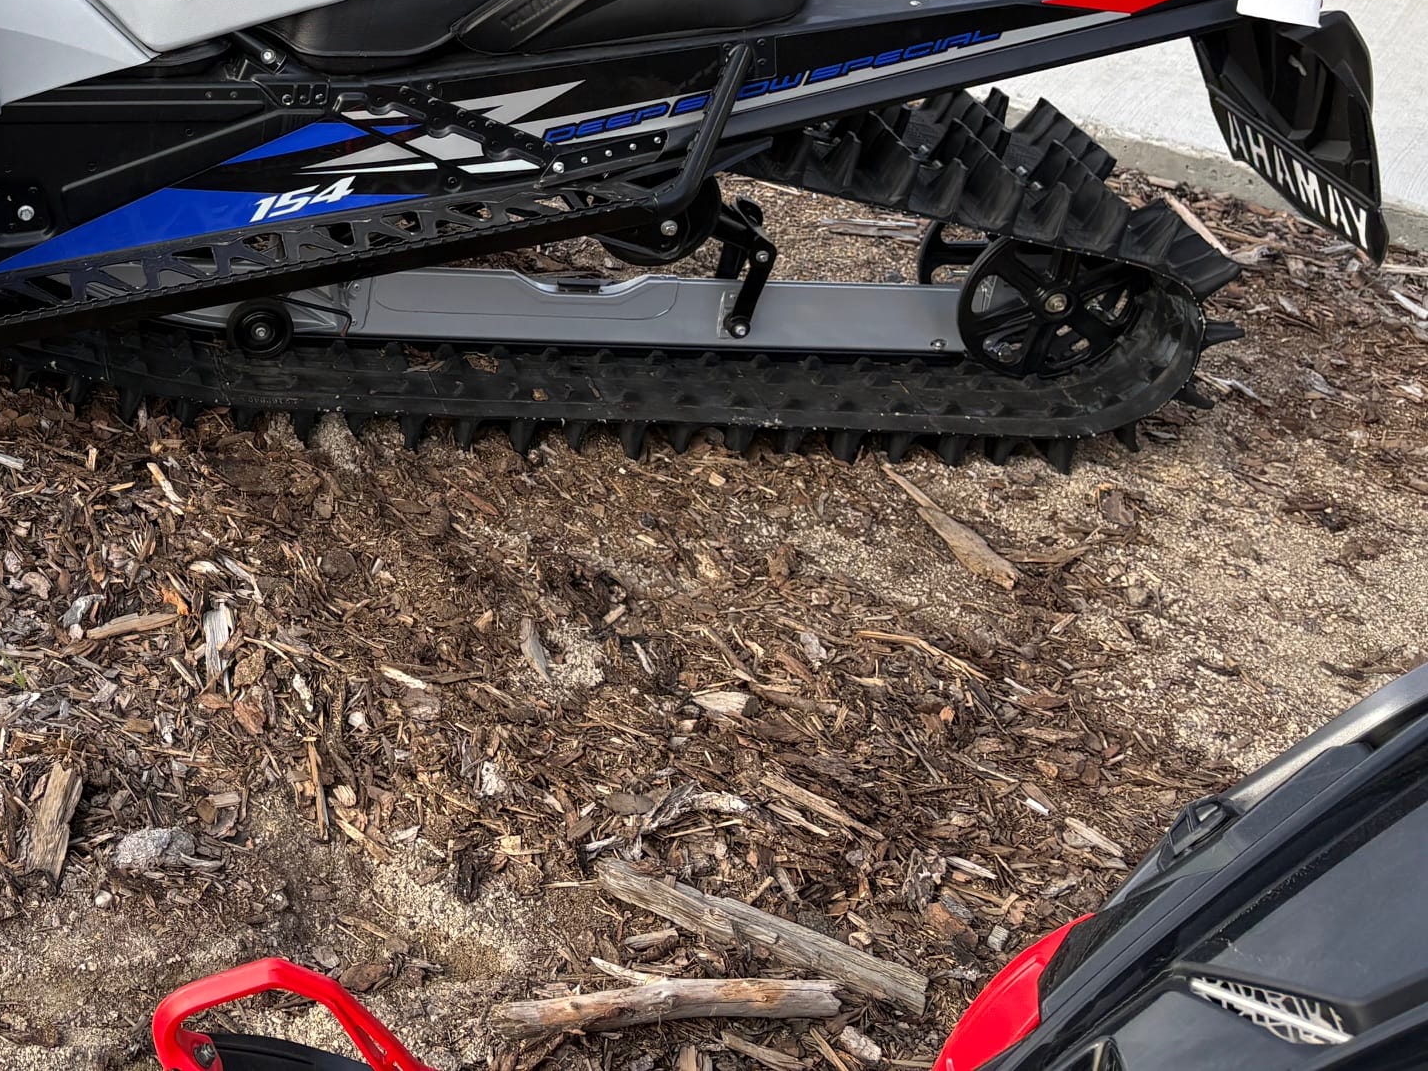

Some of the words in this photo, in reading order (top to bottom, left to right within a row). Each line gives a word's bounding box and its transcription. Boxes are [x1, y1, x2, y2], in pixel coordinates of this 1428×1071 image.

[543, 101, 670, 143] DEEP
[672, 71, 803, 115] SOW
[809, 29, 1003, 81] SPECIAL
[249, 175, 357, 223] 154
